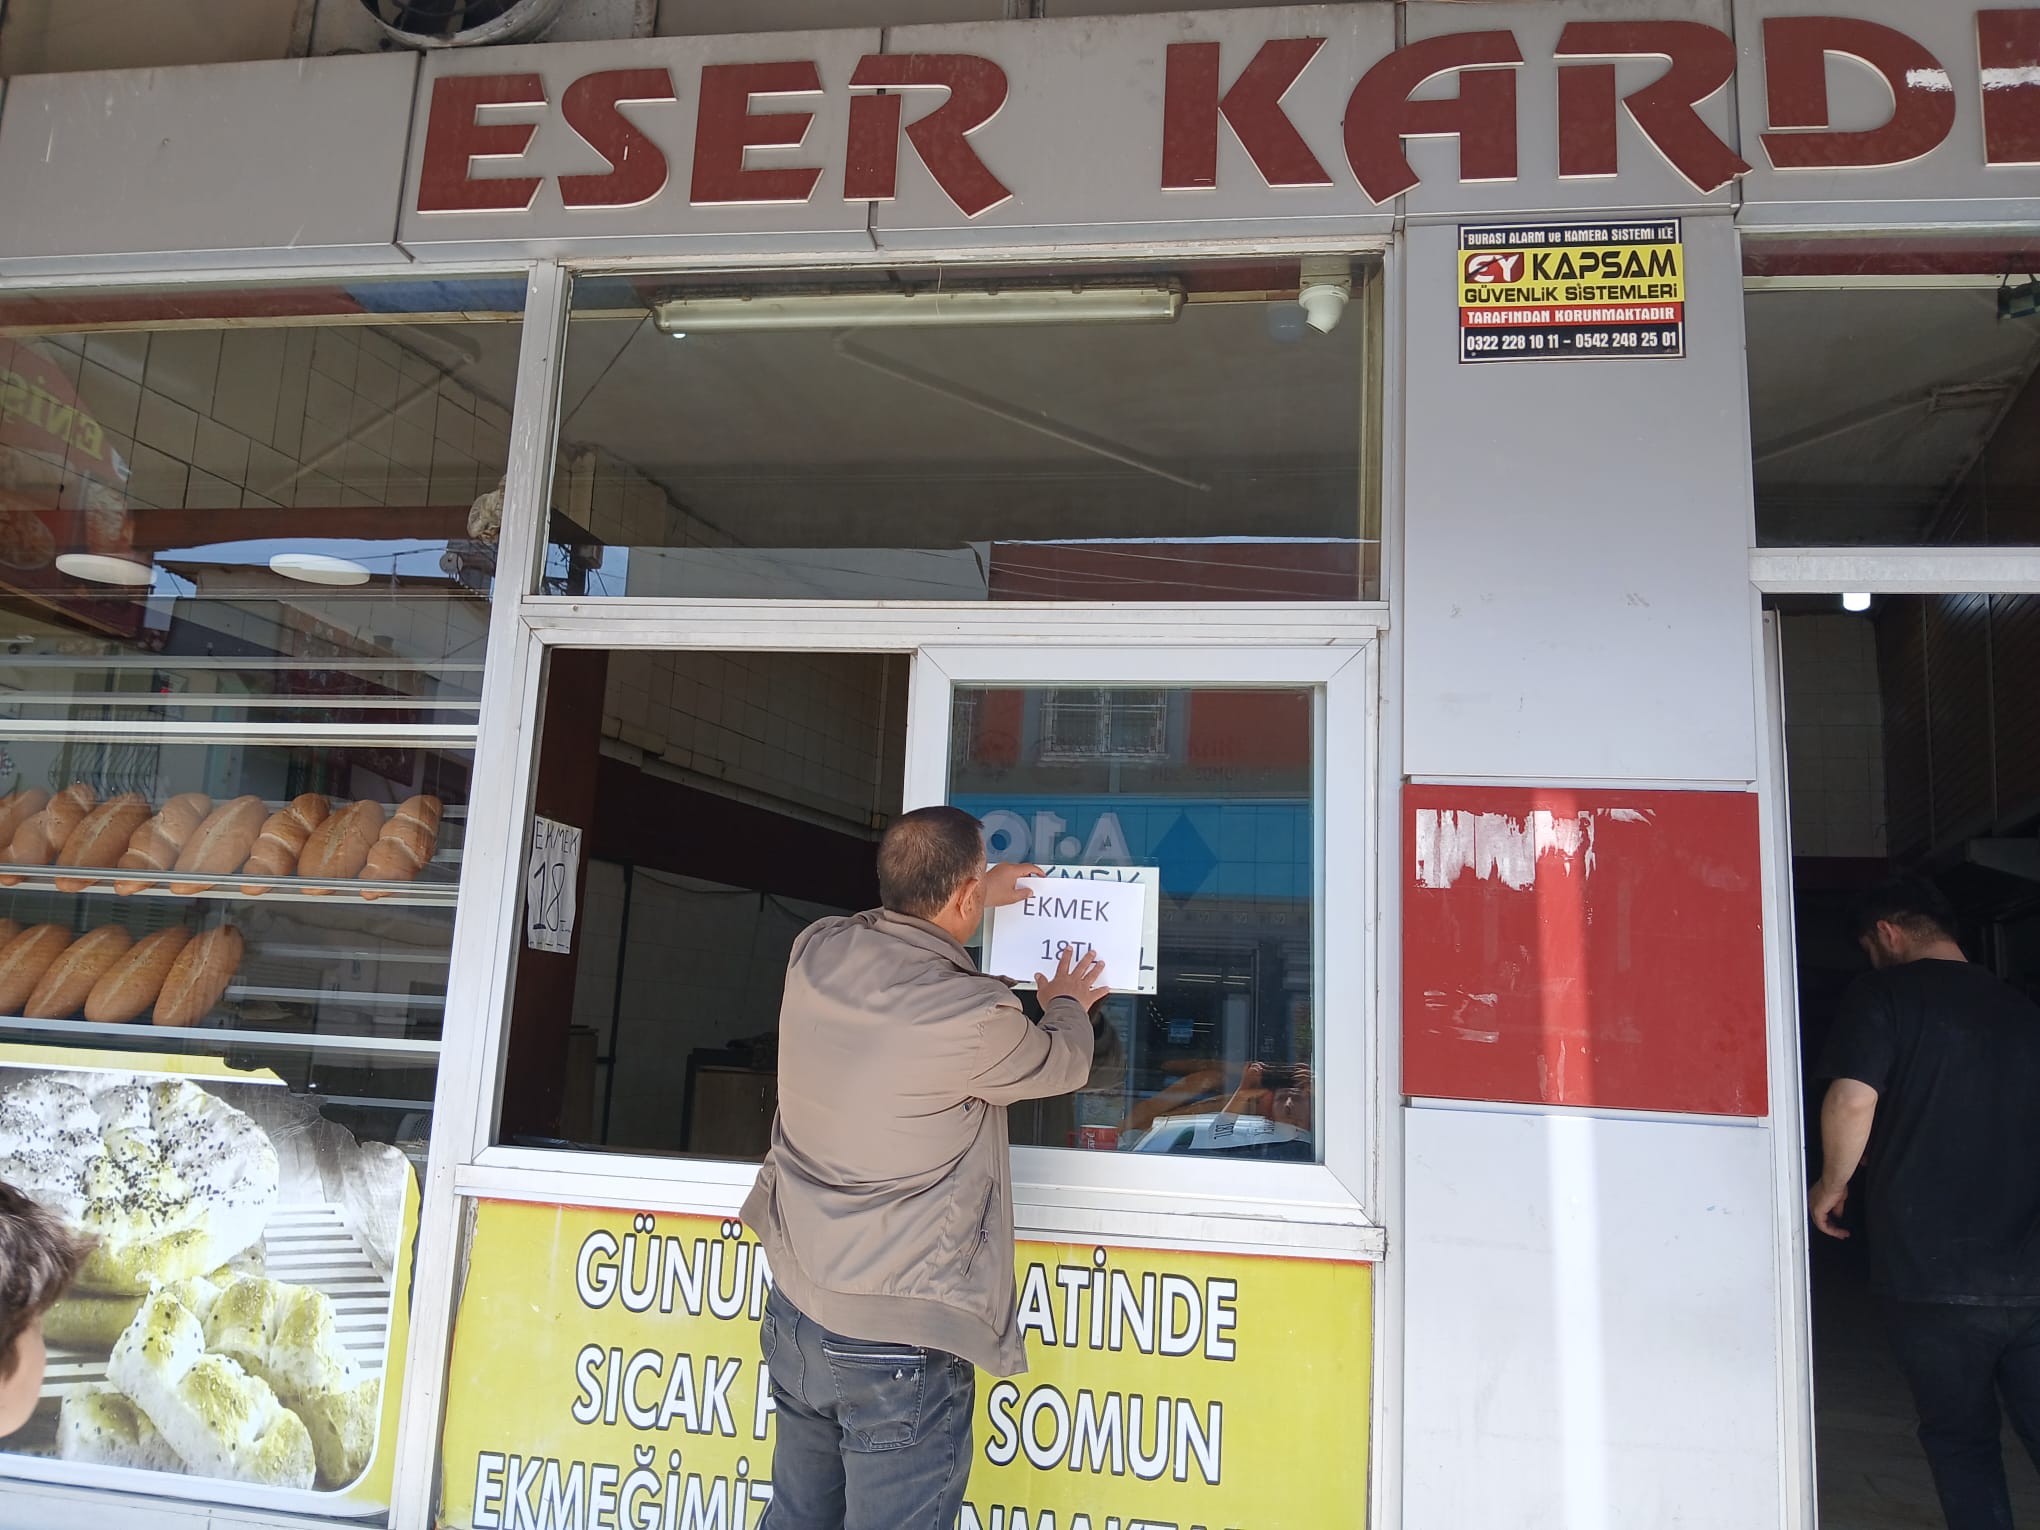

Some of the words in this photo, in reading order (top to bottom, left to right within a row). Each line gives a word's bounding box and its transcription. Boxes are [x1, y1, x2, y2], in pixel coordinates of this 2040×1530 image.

[417, 53, 1014, 220] ESER
[1468, 232, 1506, 245] BURASI
[1508, 231, 1545, 244] ALARM
[1564, 229, 1608, 242] KAMERA
[1533, 249, 1677, 280] KAPSAM
[1467, 310, 1550, 324] TARAFINDAN
[1555, 307, 1675, 322] KORUNMAKTADIR
[1467, 336, 1498, 350] 0322
[1502, 335, 1526, 349] 228
[1529, 335, 1544, 349] 10
[1547, 334, 1559, 348] 11
[1575, 333, 1608, 348] 0542
[1612, 333, 1638, 347] 248
[1641, 332, 1658, 346] 25
[1662, 331, 1676, 346] 01
[536, 820, 580, 856] EKMEK
[533, 861, 566, 932] 18
[1023, 896, 1110, 922] EKMEK
[1015, 1245, 1238, 1361] ATİNDE
[571, 1343, 741, 1438] SICAK
[985, 1380, 1223, 1486] SOMUN
